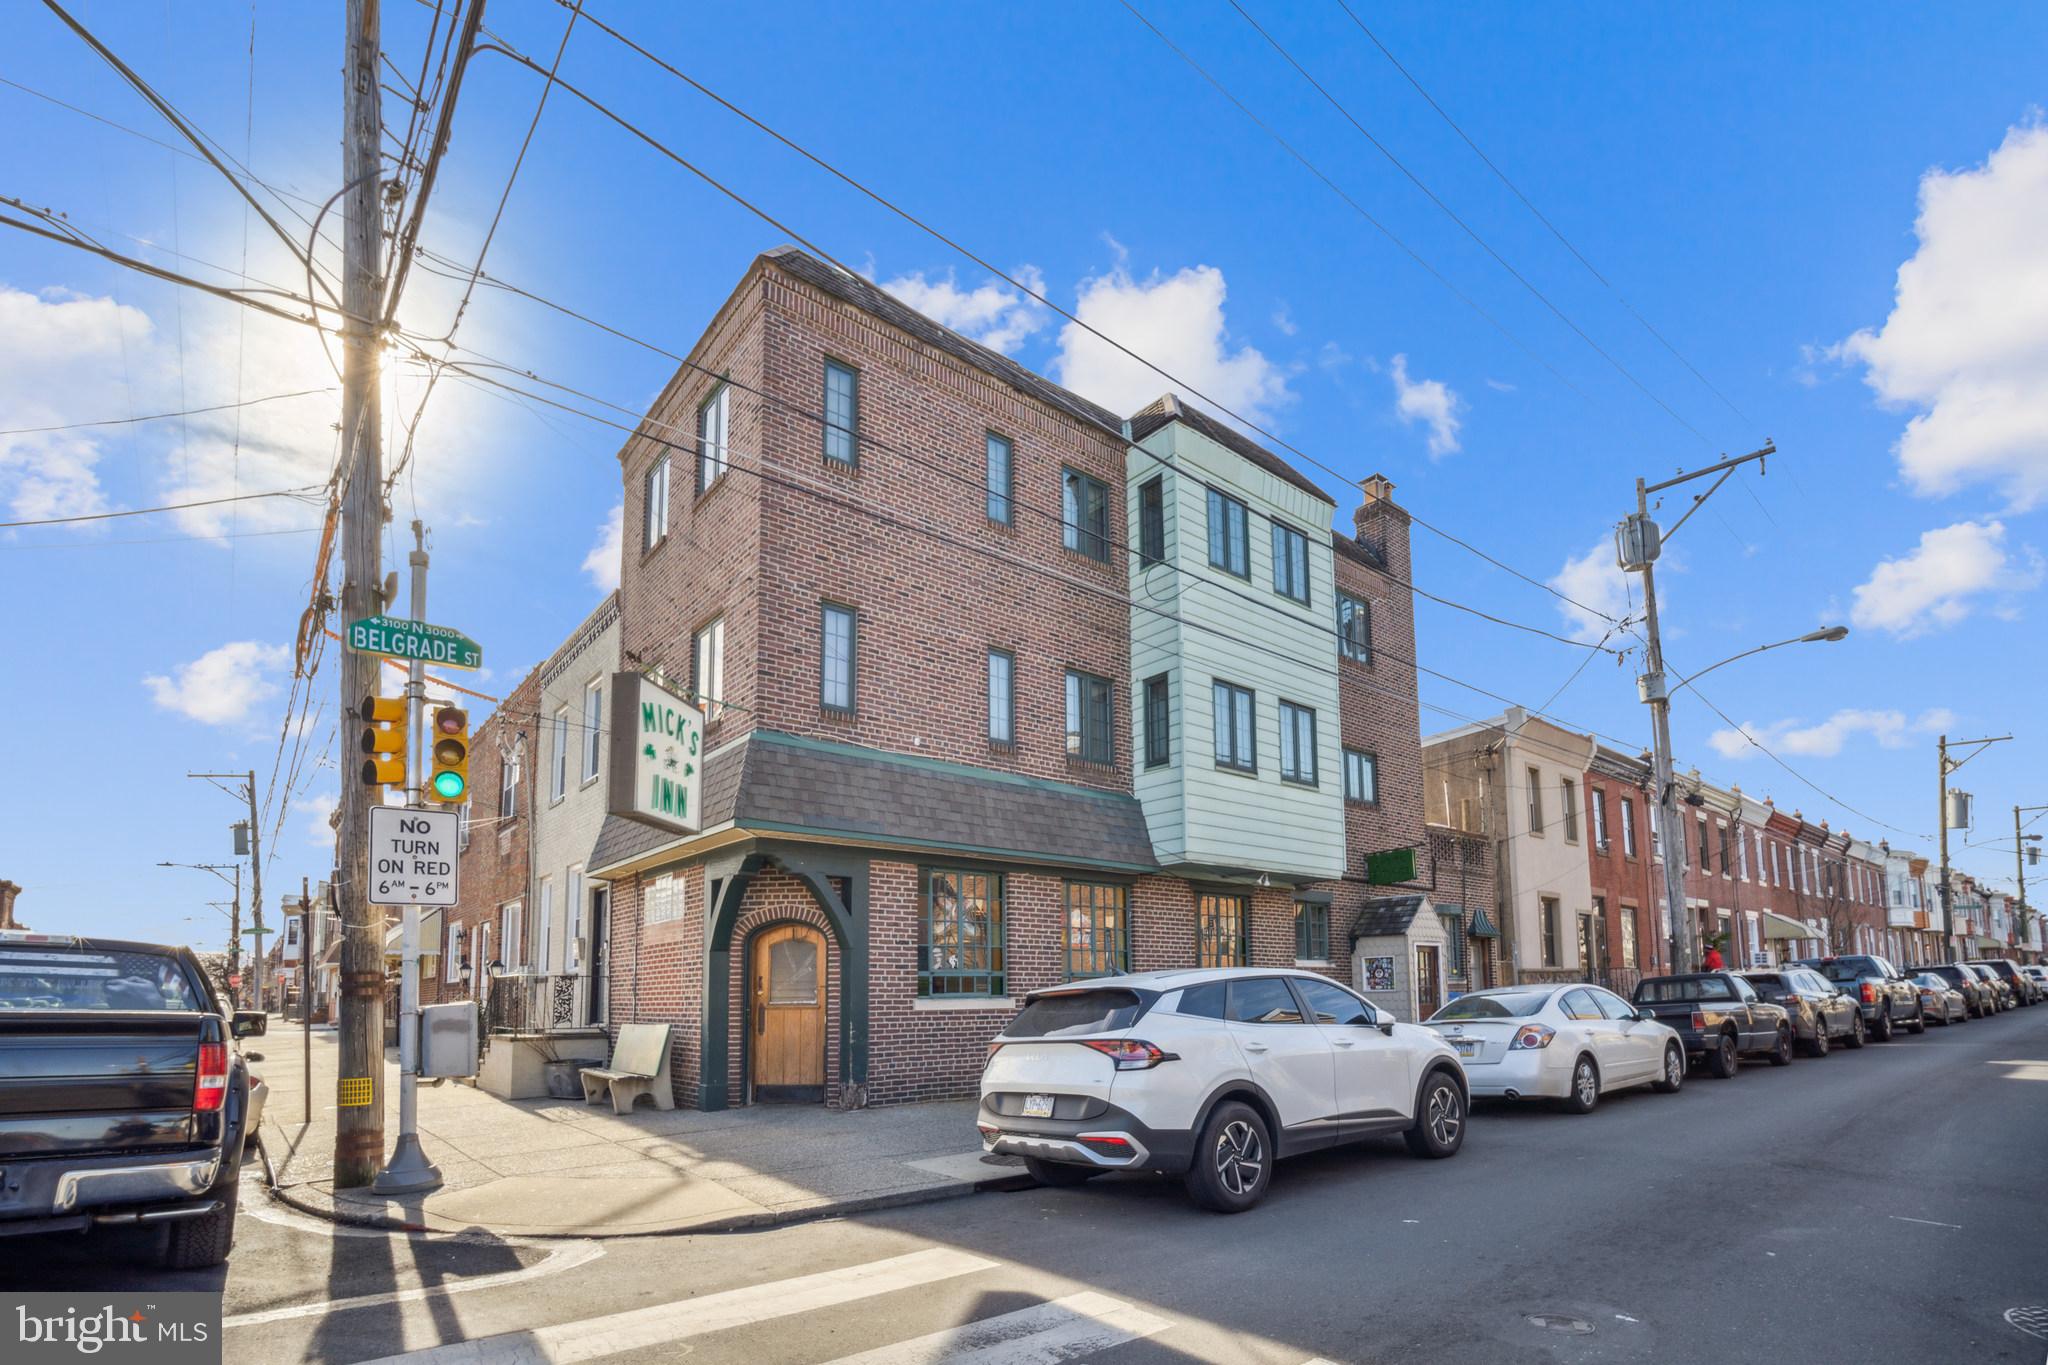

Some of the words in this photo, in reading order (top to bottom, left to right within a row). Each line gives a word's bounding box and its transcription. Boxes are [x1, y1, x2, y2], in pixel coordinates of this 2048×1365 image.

[381, 618, 409, 631] 3100
[412, 622, 424, 635] N
[425, 627, 455, 639] 3000
[354, 626, 457, 663] BELGRADE
[464, 651, 480, 667] ST
[641, 701, 700, 757] MICK'S
[651, 774, 688, 819] INN
[400, 819, 431, 835] NO
[391, 839, 440, 856] TURN
[378, 858, 404, 874] ON
[414, 861, 451, 876] RED
